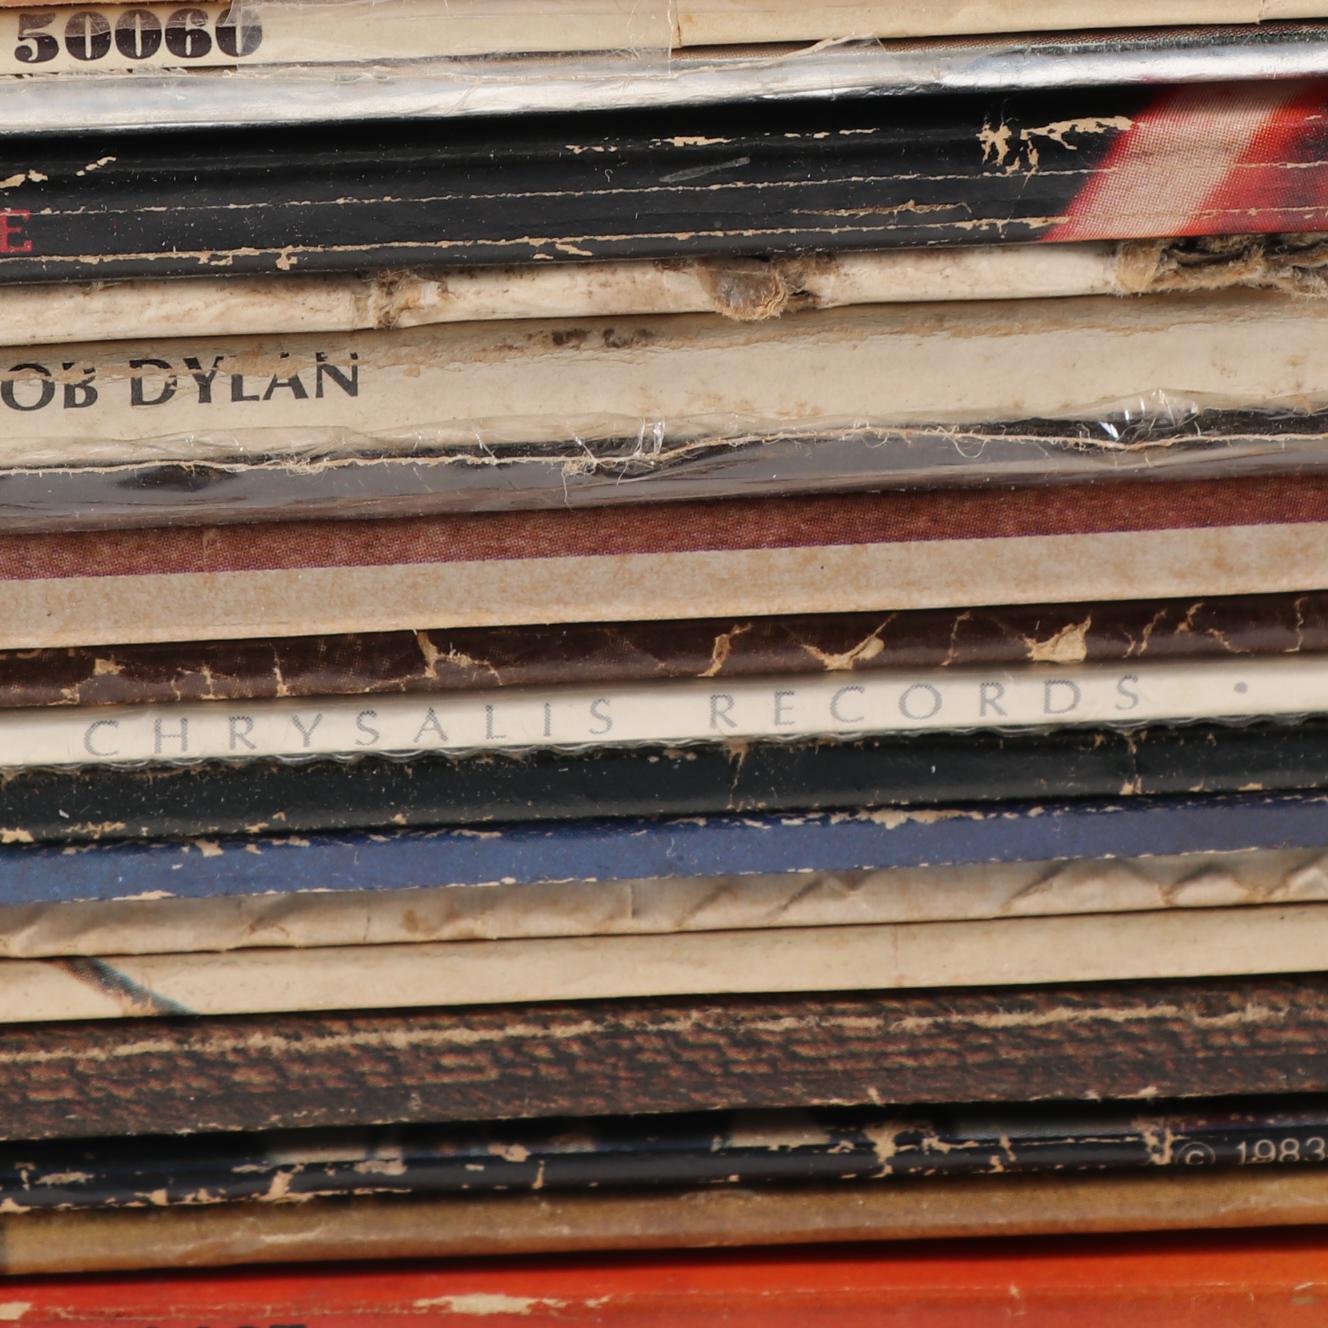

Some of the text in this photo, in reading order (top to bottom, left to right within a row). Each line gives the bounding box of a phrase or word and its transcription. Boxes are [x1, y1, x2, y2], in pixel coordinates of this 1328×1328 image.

[15, 7, 264, 64] 50060
[129, 351, 360, 406] DYLAN
[84, 698, 614, 758] CHRYSALIS
[707, 674, 1141, 726] RECORDS
